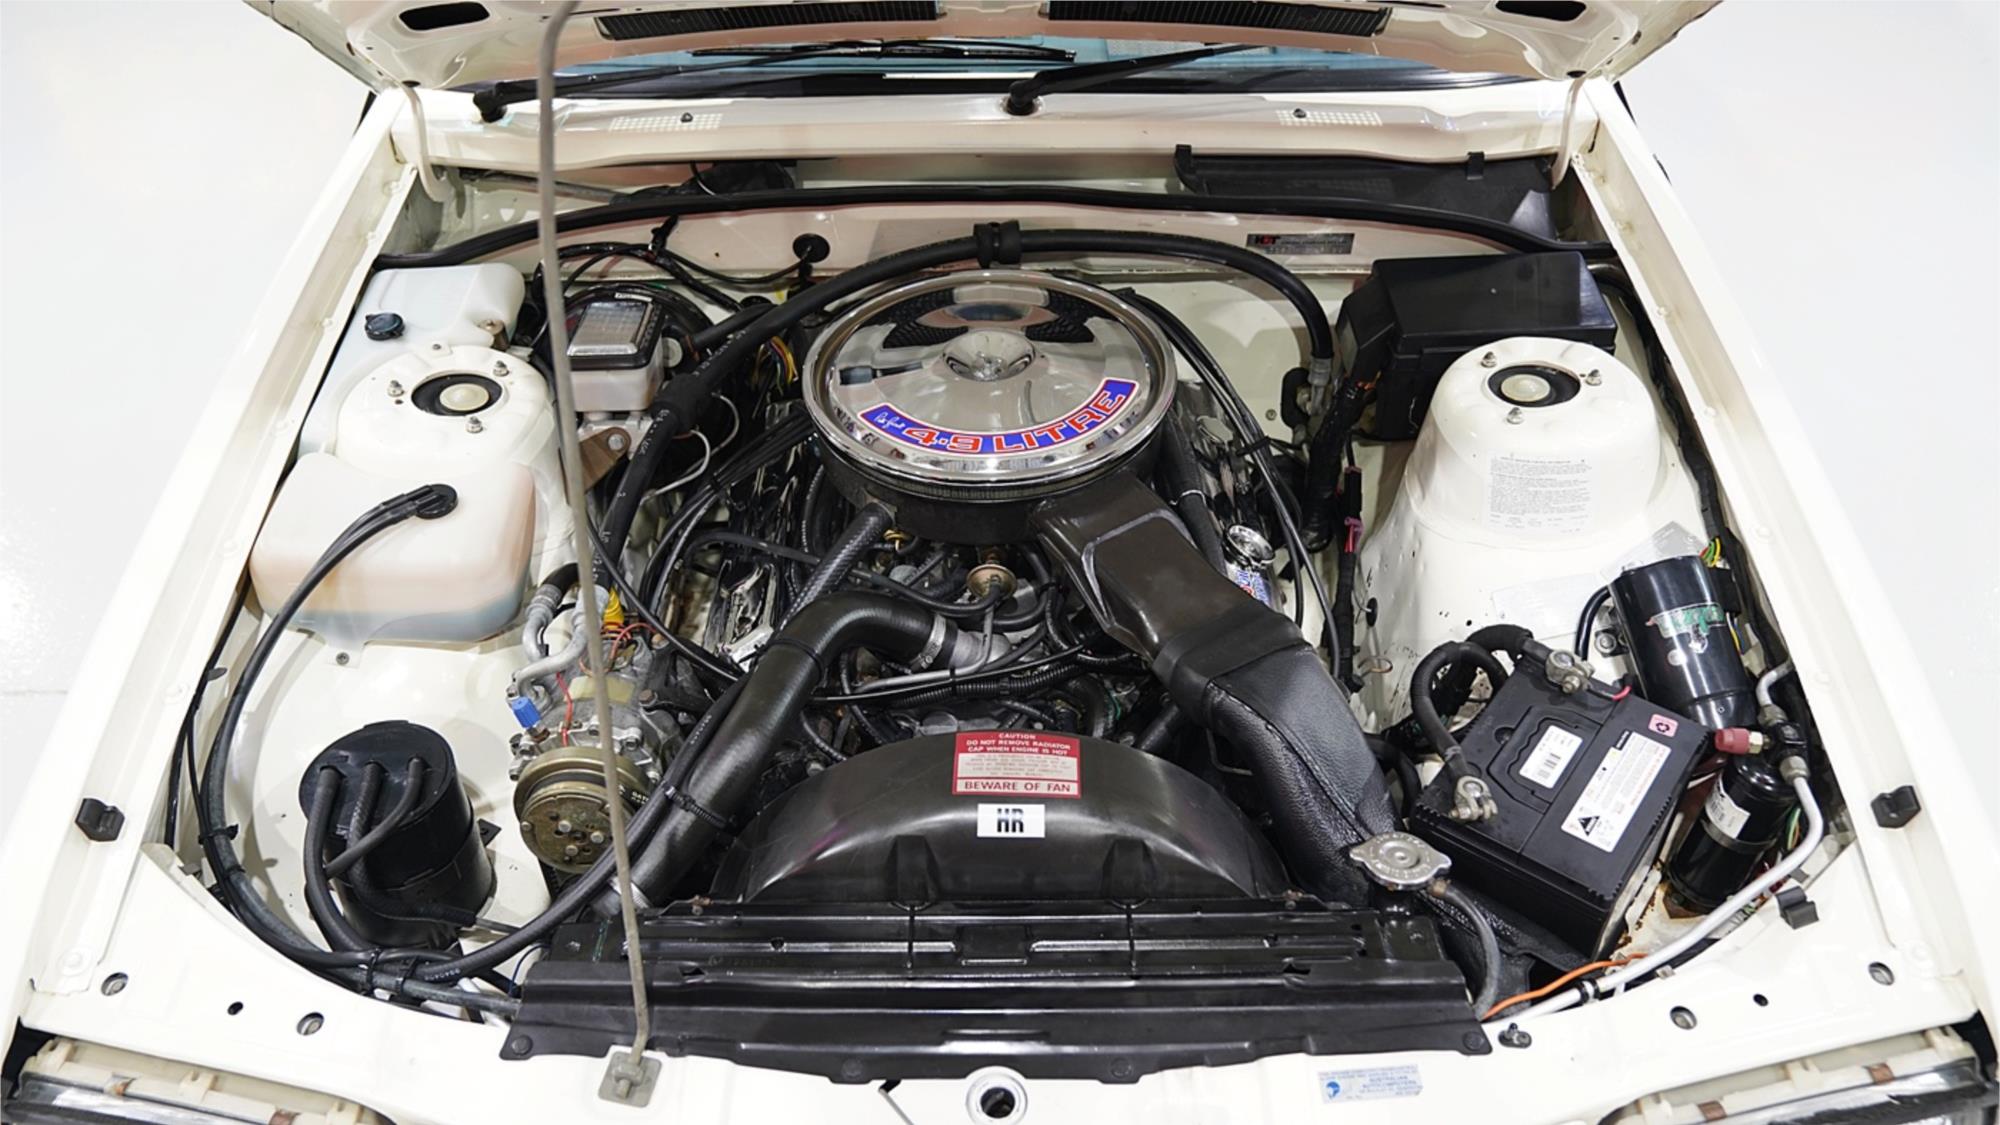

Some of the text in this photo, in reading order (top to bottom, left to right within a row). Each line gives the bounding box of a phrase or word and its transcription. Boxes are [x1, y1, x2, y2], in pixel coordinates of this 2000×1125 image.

[993, 390, 1126, 452] LITRE
[1032, 741, 1071, 750] RADIATOR
[964, 780, 1071, 793] BEWARE OF FAN
[996, 808, 1025, 832] HR
